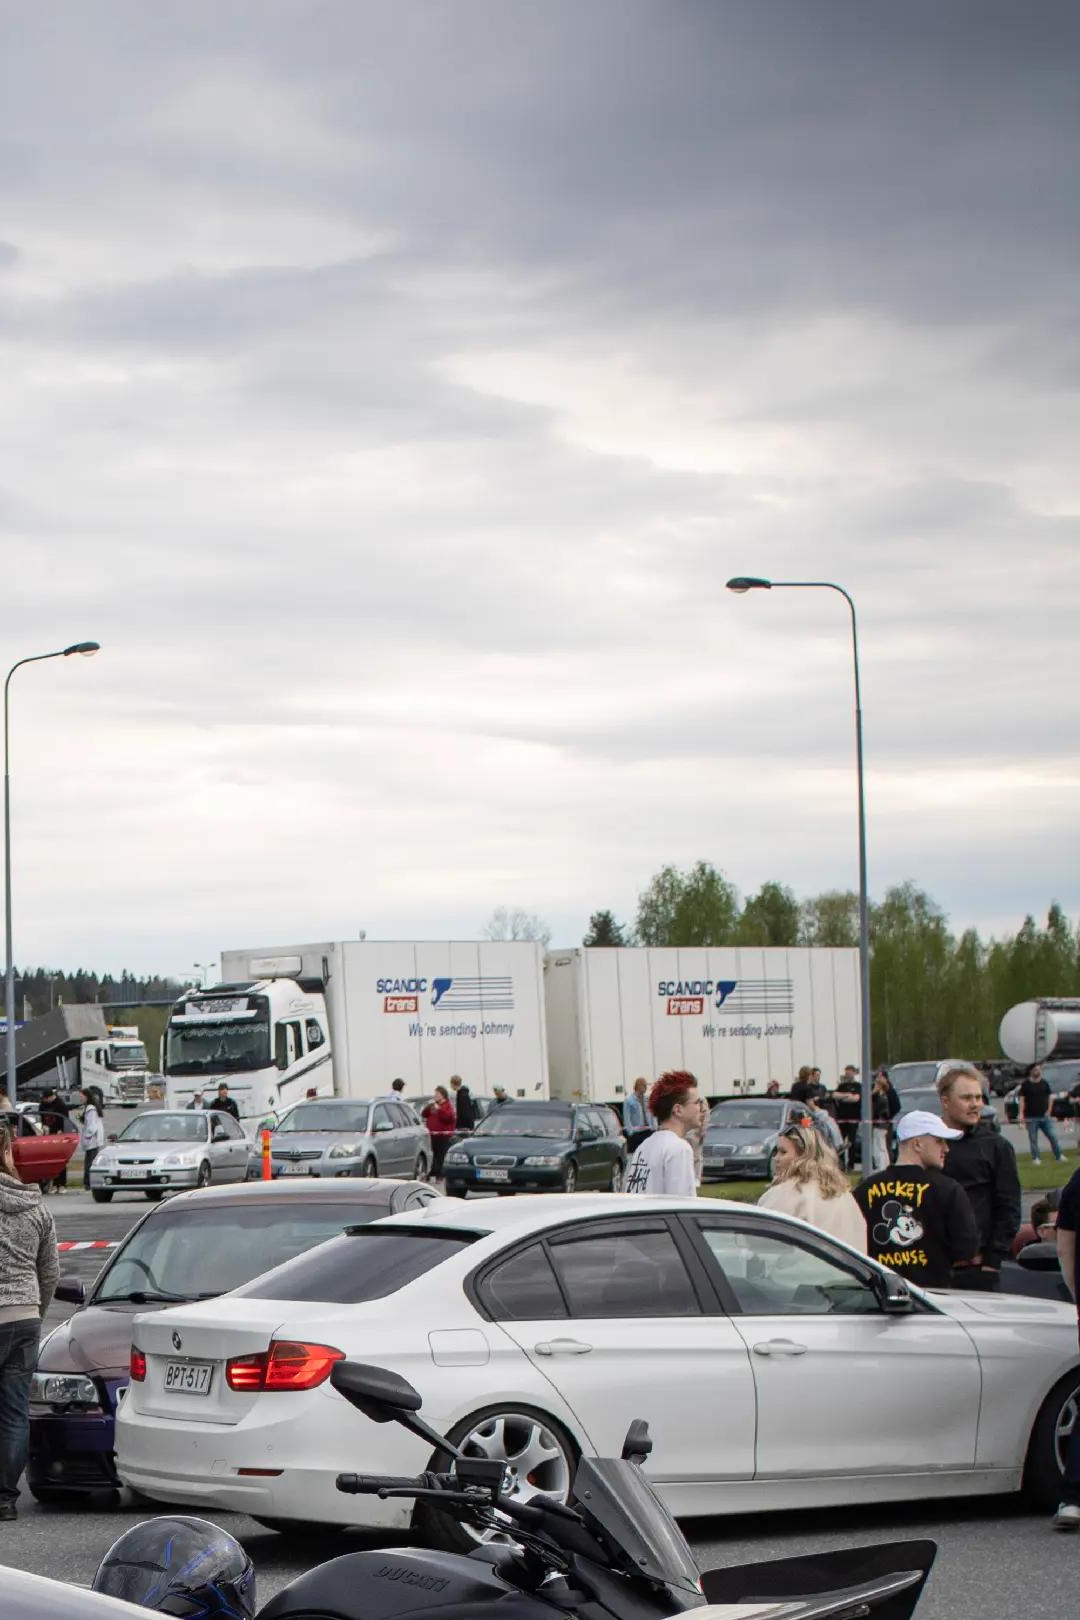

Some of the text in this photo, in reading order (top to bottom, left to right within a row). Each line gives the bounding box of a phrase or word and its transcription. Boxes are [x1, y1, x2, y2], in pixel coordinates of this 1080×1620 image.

[376, 979, 427, 993] SCANDIC
[658, 981, 713, 996] SCANDIC
[386, 998, 416, 1011] trans
[670, 999, 701, 1014] trans
[439, 1022, 477, 1038] sending
[480, 1021, 514, 1038] Johnny
[729, 1024, 761, 1039] sending
[764, 1023, 794, 1039] Johnny
[867, 1181, 930, 1208] MICKEY
[878, 1250, 928, 1267] MOUSE
[166, 1366, 208, 1389] BPT-517
